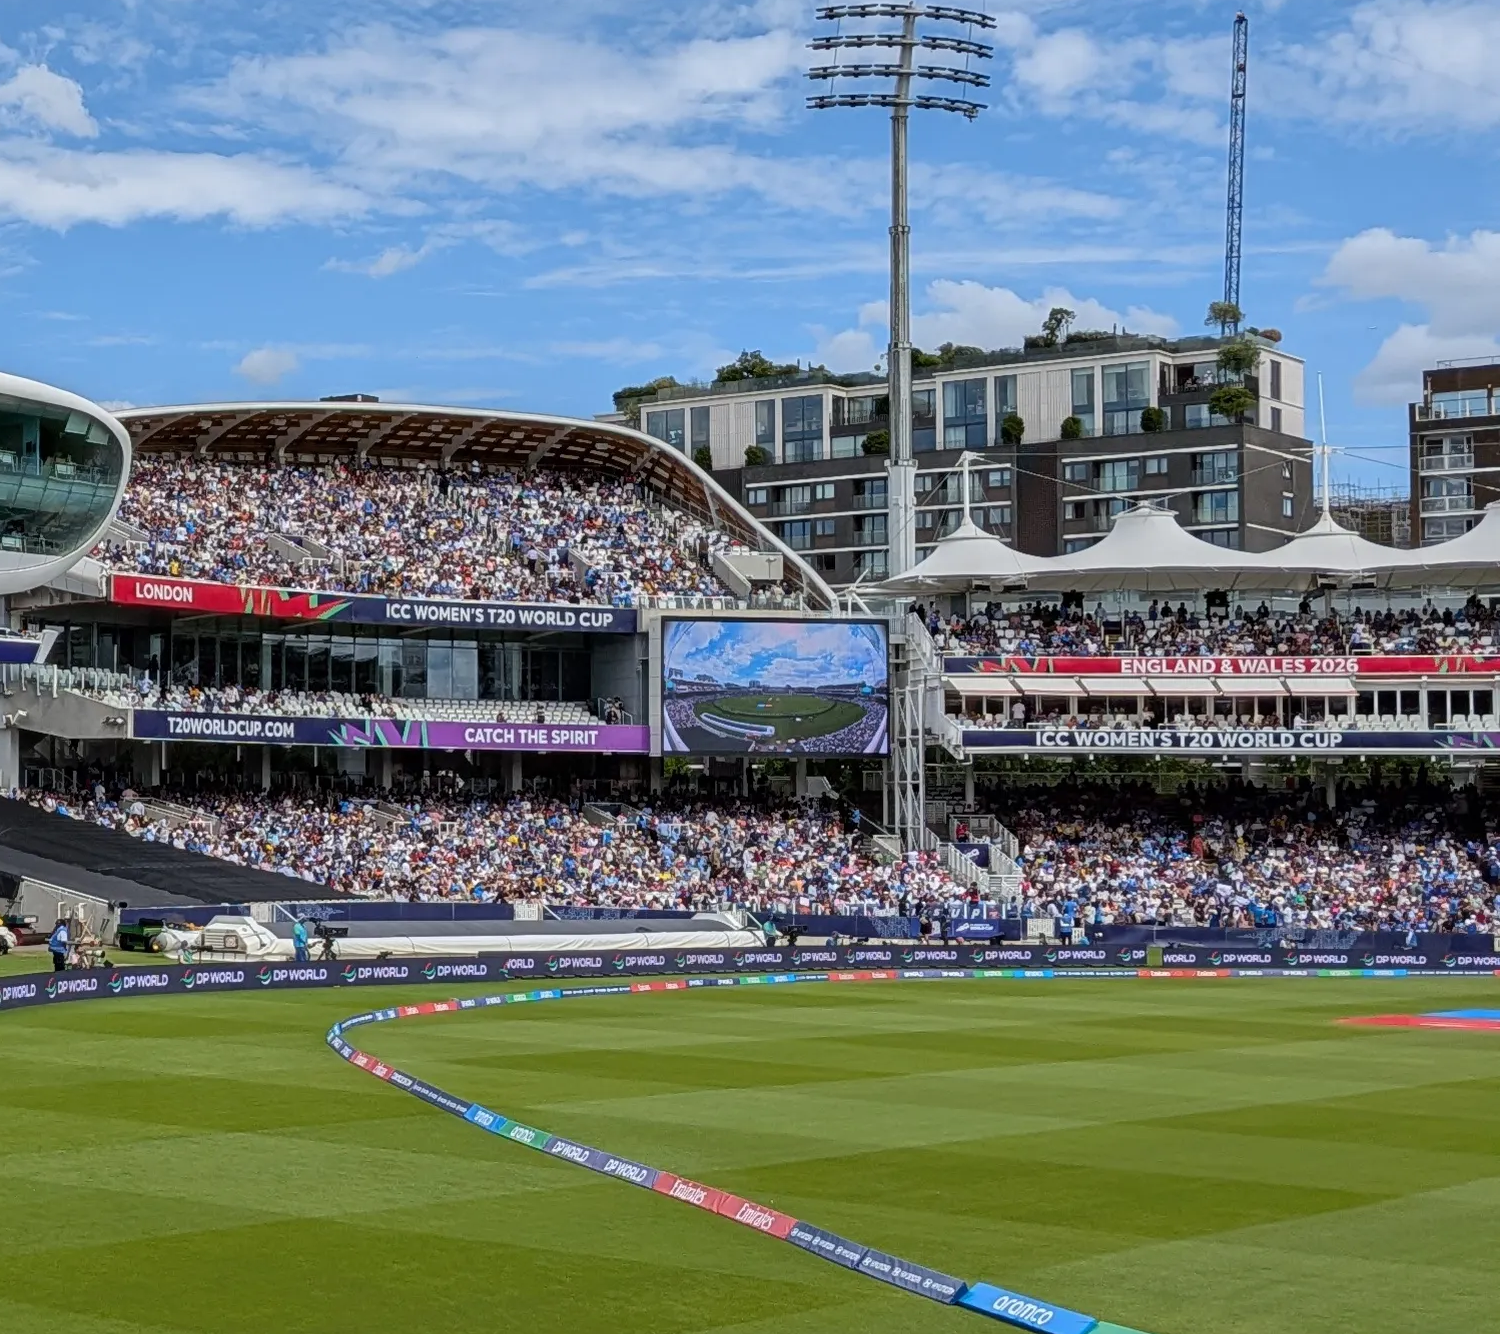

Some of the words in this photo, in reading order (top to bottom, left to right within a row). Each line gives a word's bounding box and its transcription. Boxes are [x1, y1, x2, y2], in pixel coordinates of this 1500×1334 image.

[135, 581, 193, 603] LONDON
[386, 602, 412, 620] ICC
[414, 604, 485, 624] WOMEN'S
[488, 606, 515, 624] T20
[518, 607, 576, 627] WORLD
[579, 609, 613, 628] CUP
[1121, 659, 1217, 674] ENGLAND
[1220, 659, 1234, 674] &
[1237, 658, 1306, 674] WALES
[1309, 658, 1359, 673] 2026
[167, 716, 295, 739] T20WORLDCUP.COM
[464, 727, 515, 744] CATCH
[518, 729, 547, 745] THE
[551, 729, 599, 746] SPIRIT
[1036, 731, 1070, 747] ICC
[1073, 731, 1173, 747] WOMEN'S
[1176, 731, 1214, 747] T20
[1217, 731, 1297, 748] WORLD
[1299, 732, 1343, 748] CUP
[686, 955, 698, 965] DP
[698, 954, 724, 965] WORLD
[745, 954, 756, 964] DP
[757, 953, 782, 964] WORLD
[802, 952, 812, 962] DP
[812, 951, 837, 962] WORLD
[855, 951, 866, 961] DP
[866, 951, 891, 961] WORLD
[914, 951, 927, 960] DP
[928, 951, 957, 960] WORLD
[985, 950, 999, 960] DP
[999, 950, 1031, 960] WORLD
[1058, 950, 1071, 960] DP
[1072, 950, 1106, 960] WORLD
[1132, 949, 1145, 959] DP
[1223, 954, 1236, 963] DP
[1237, 954, 1271, 963] WORLD
[1300, 954, 1314, 964] DP
[1314, 954, 1348, 964] WORLD
[1376, 955, 1390, 964] DP
[1390, 955, 1426, 965] WORLD
[559, 957, 572, 969] DP
[573, 956, 602, 968] WORLD
[626, 956, 637, 967] DP
[637, 955, 665, 966] WORLD
[1458, 956, 1472, 966] DP
[273, 969, 288, 982] DP
[289, 968, 327, 981] WORLD
[358, 967, 373, 979] DP
[374, 966, 408, 978] WORLD
[437, 965, 452, 976] DP
[453, 964, 487, 976] WORLD
[123, 976, 136, 988] DP
[137, 973, 168, 987] WORLD
[196, 972, 210, 984] DP
[211, 970, 245, 984] WORLD
[3, 987, 13, 1001] DP
[14, 983, 36, 999] WORLD
[58, 981, 69, 993] DP
[70, 978, 97, 992] WORLD
[552, 1141, 564, 1154] DP
[562, 1144, 590, 1162] WORLD
[604, 1158, 618, 1172] DP
[616, 1163, 647, 1182] WORLD
[669, 1179, 707, 1204] Emirates
[735, 1203, 775, 1230] Emirates
[993, 1294, 1054, 1326] aramco
